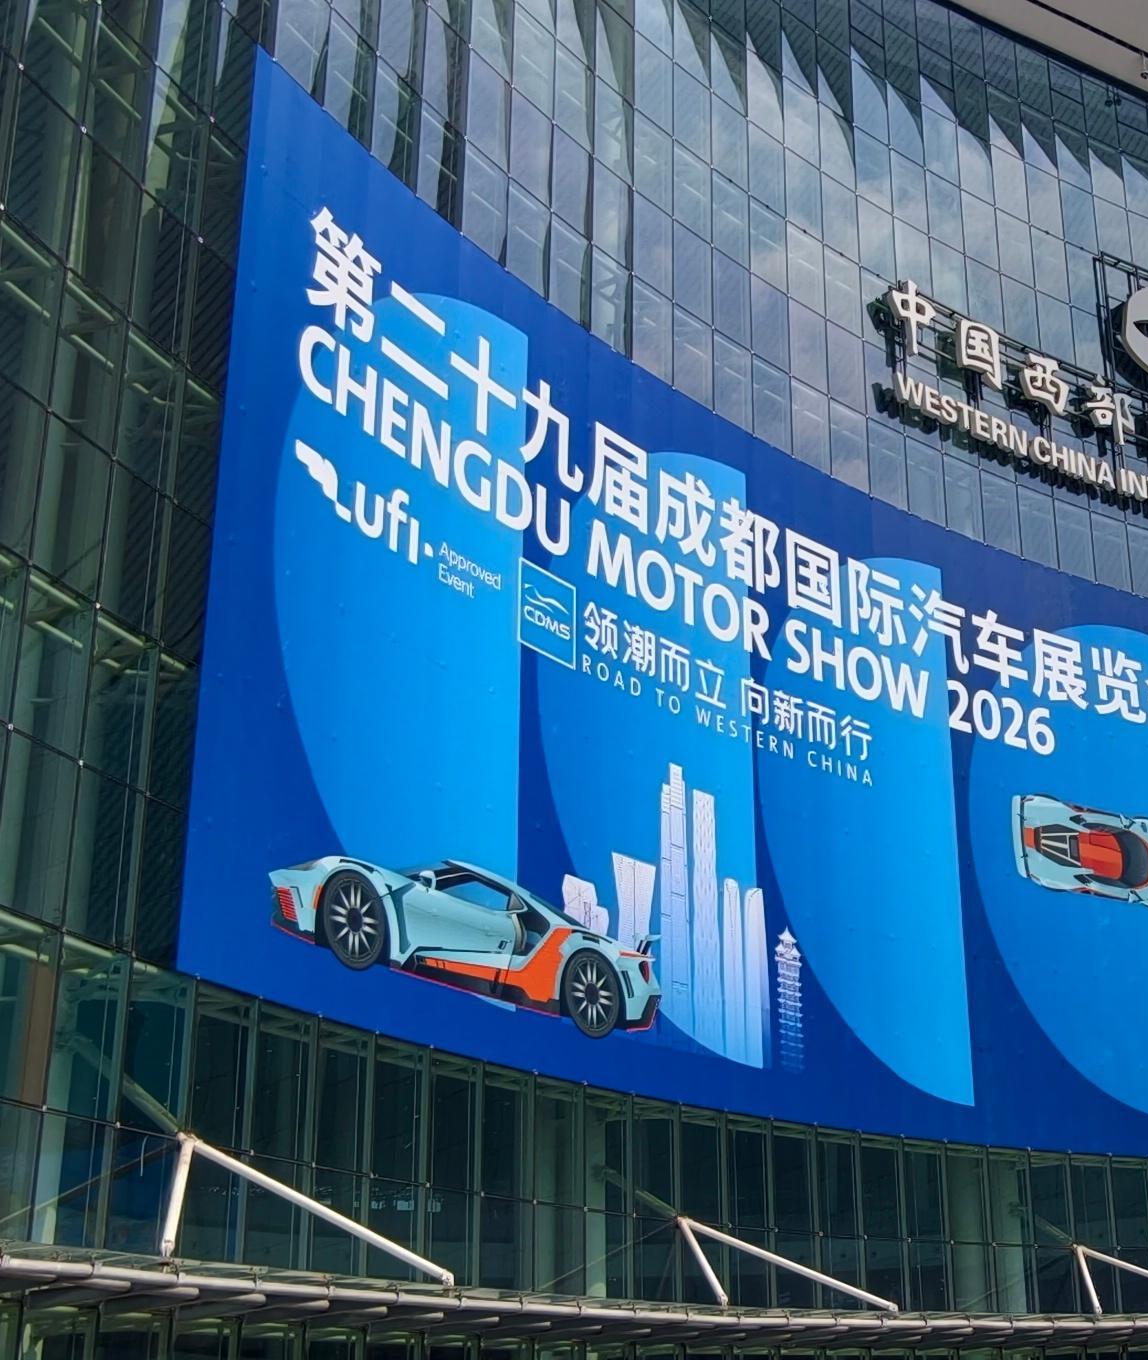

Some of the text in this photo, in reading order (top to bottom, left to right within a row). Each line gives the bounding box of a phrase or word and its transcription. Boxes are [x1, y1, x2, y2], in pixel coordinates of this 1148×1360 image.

[894, 371, 1029, 458] WESTERN
[1030, 436, 1117, 489] CHINA
[299, 324, 1056, 756] CHENGDU MOTOR SHOW 2026
[437, 563, 475, 599] Event
[438, 541, 502, 591] Approved
[523, 604, 571, 641] CDMS
[583, 601, 873, 761] 领潮而立 向新而行
[581, 653, 873, 787] ROAD TO WESTERN CHINA
